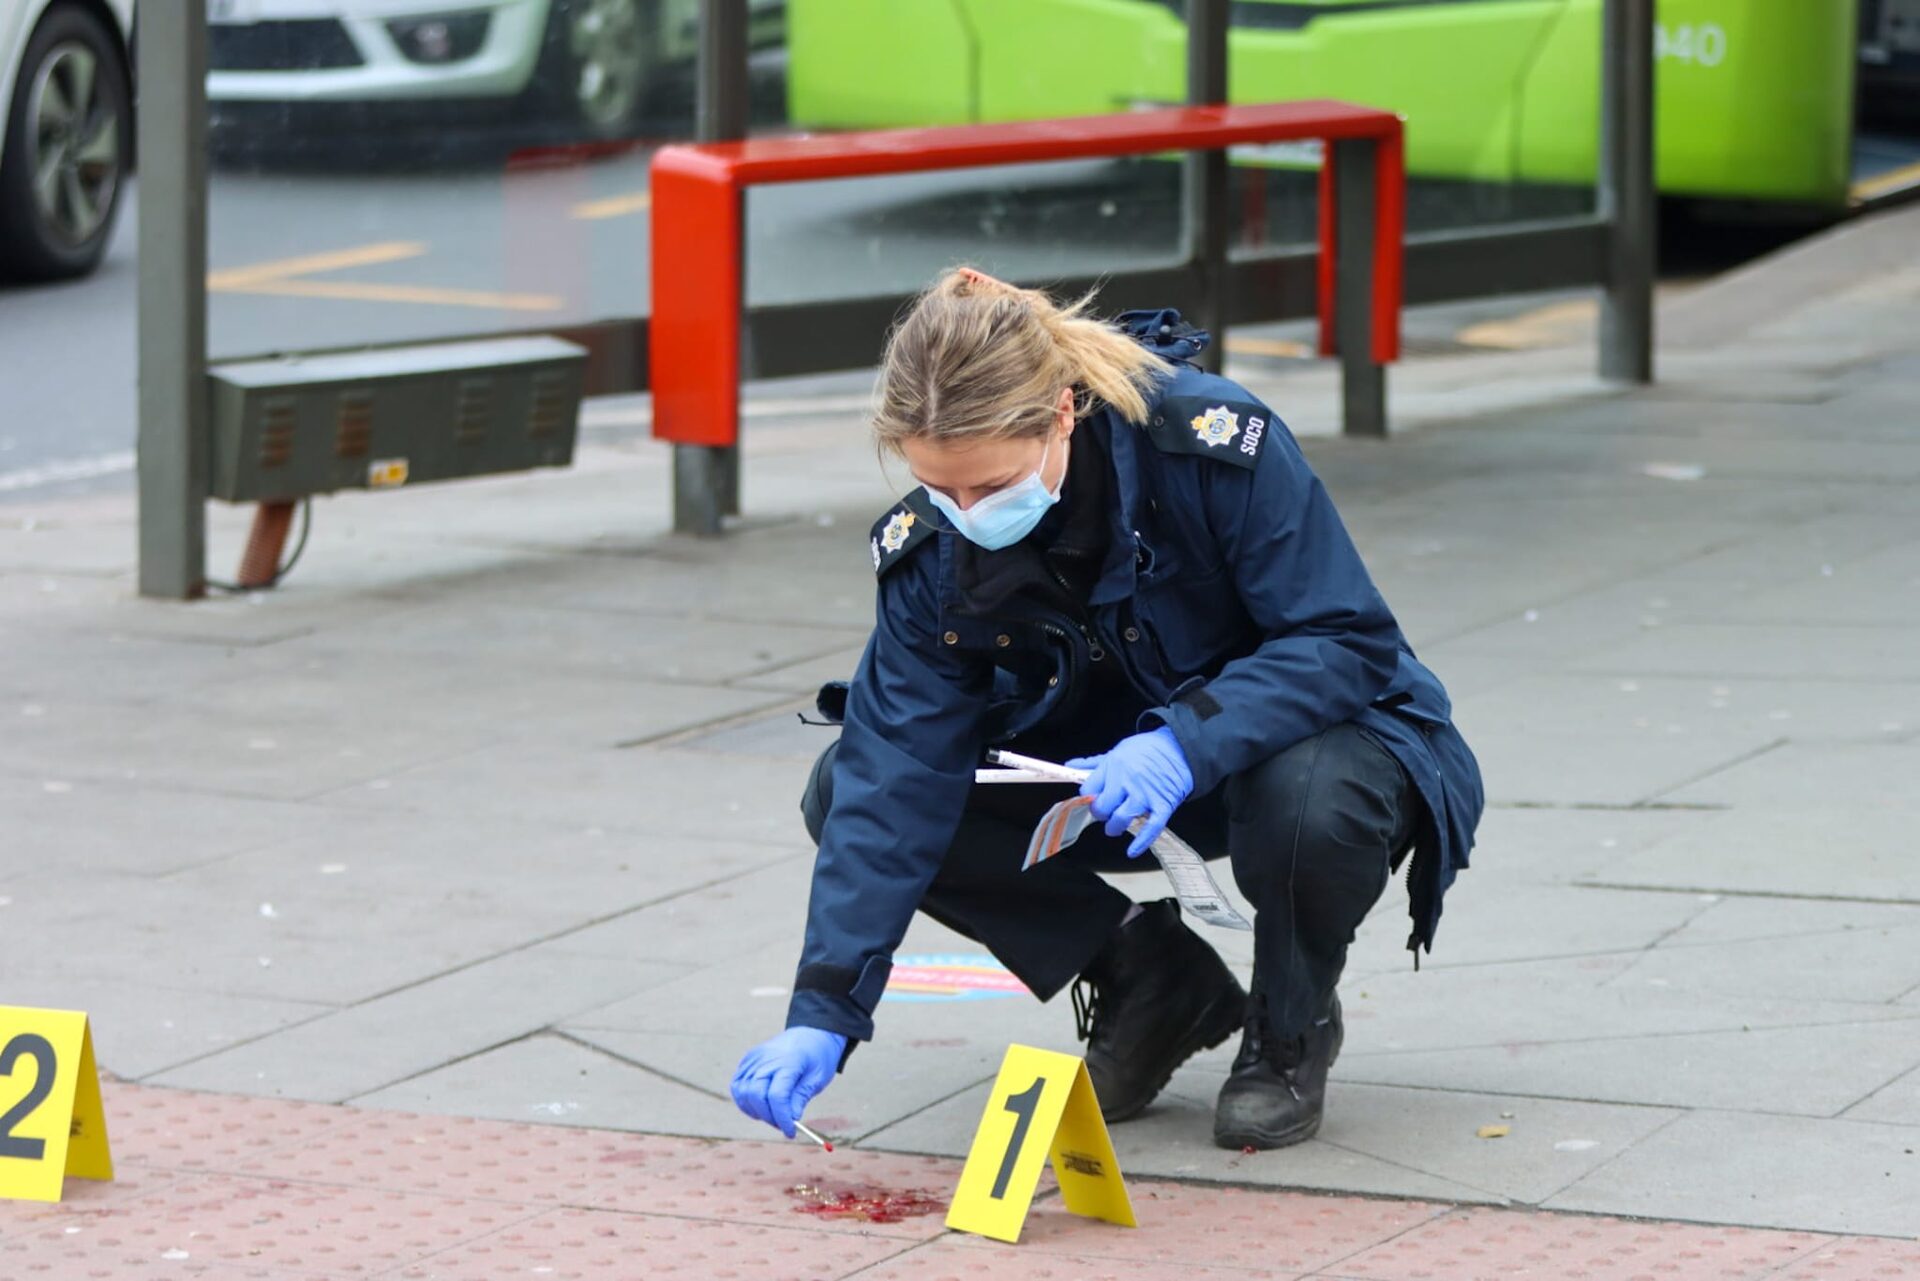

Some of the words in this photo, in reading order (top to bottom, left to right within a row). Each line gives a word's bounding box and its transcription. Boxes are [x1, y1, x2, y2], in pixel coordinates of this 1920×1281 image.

[1240, 416, 1265, 456] SOCO
[0, 1033, 57, 1160] 2
[989, 1076, 1046, 1200] 1
